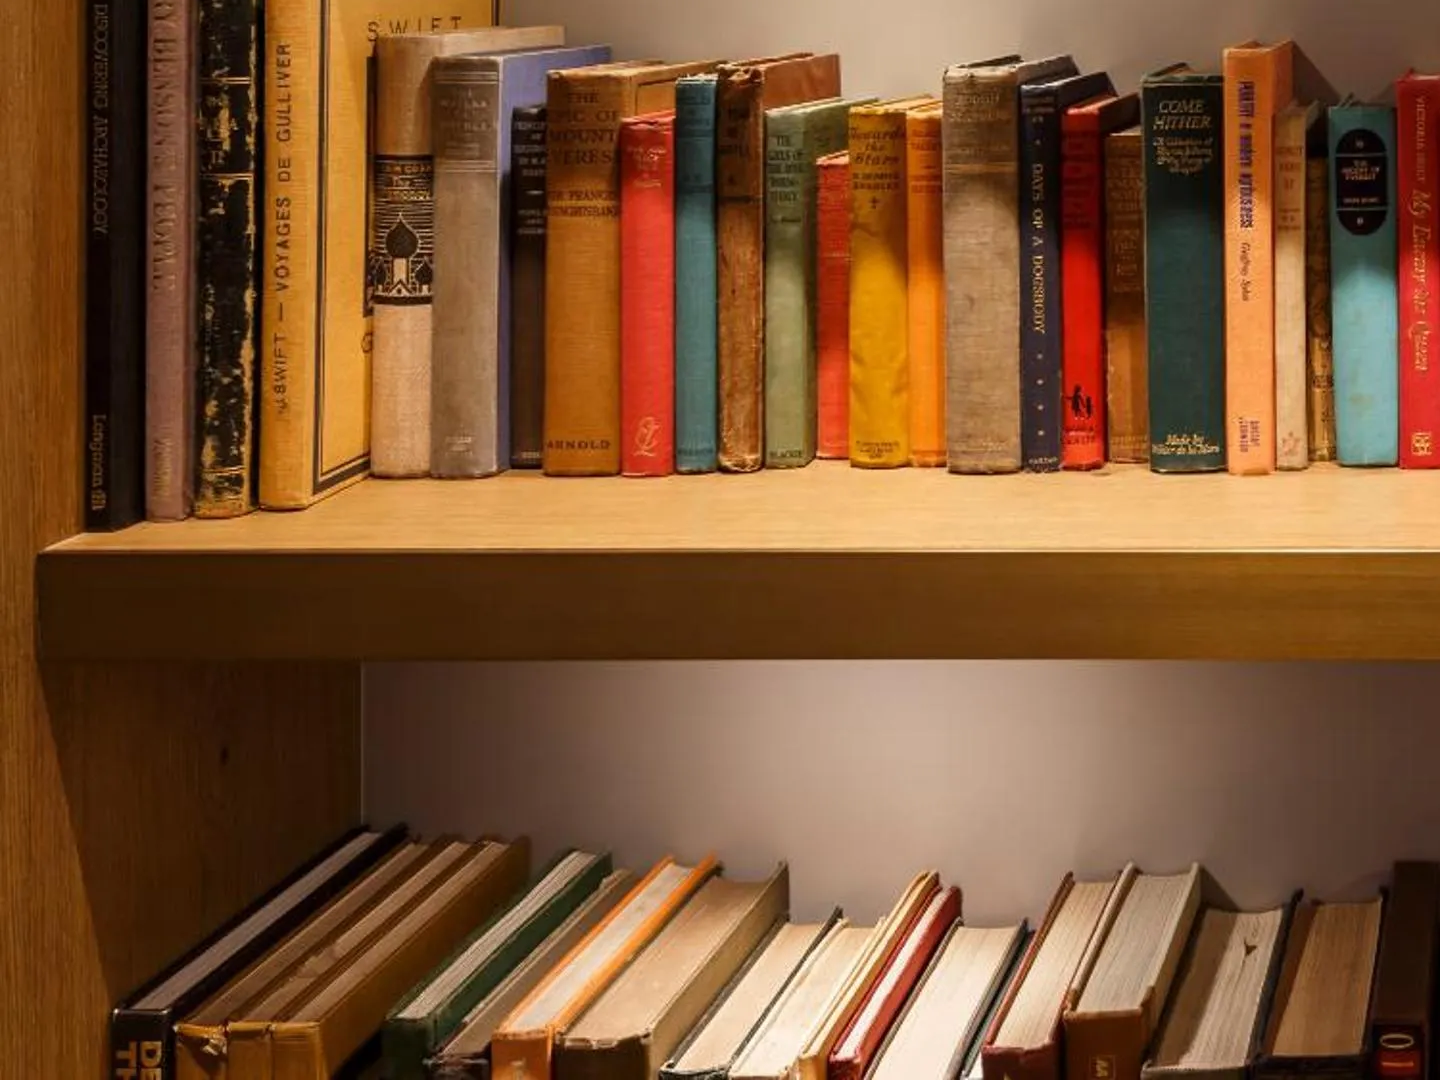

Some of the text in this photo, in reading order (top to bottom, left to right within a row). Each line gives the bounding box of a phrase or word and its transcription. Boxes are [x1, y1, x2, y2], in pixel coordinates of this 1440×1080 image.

[1158, 99, 1205, 114] COME
[1152, 115, 1213, 131] HITHER
[275, 42, 292, 294] VOYAGES DE GULLIVER
[1032, 163, 1043, 202] DAYS
[1032, 237, 1043, 247] A
[1032, 254, 1045, 335] DOGSBODY
[90, 414, 108, 484] Longman
[546, 439, 611, 450] ARNOLD
